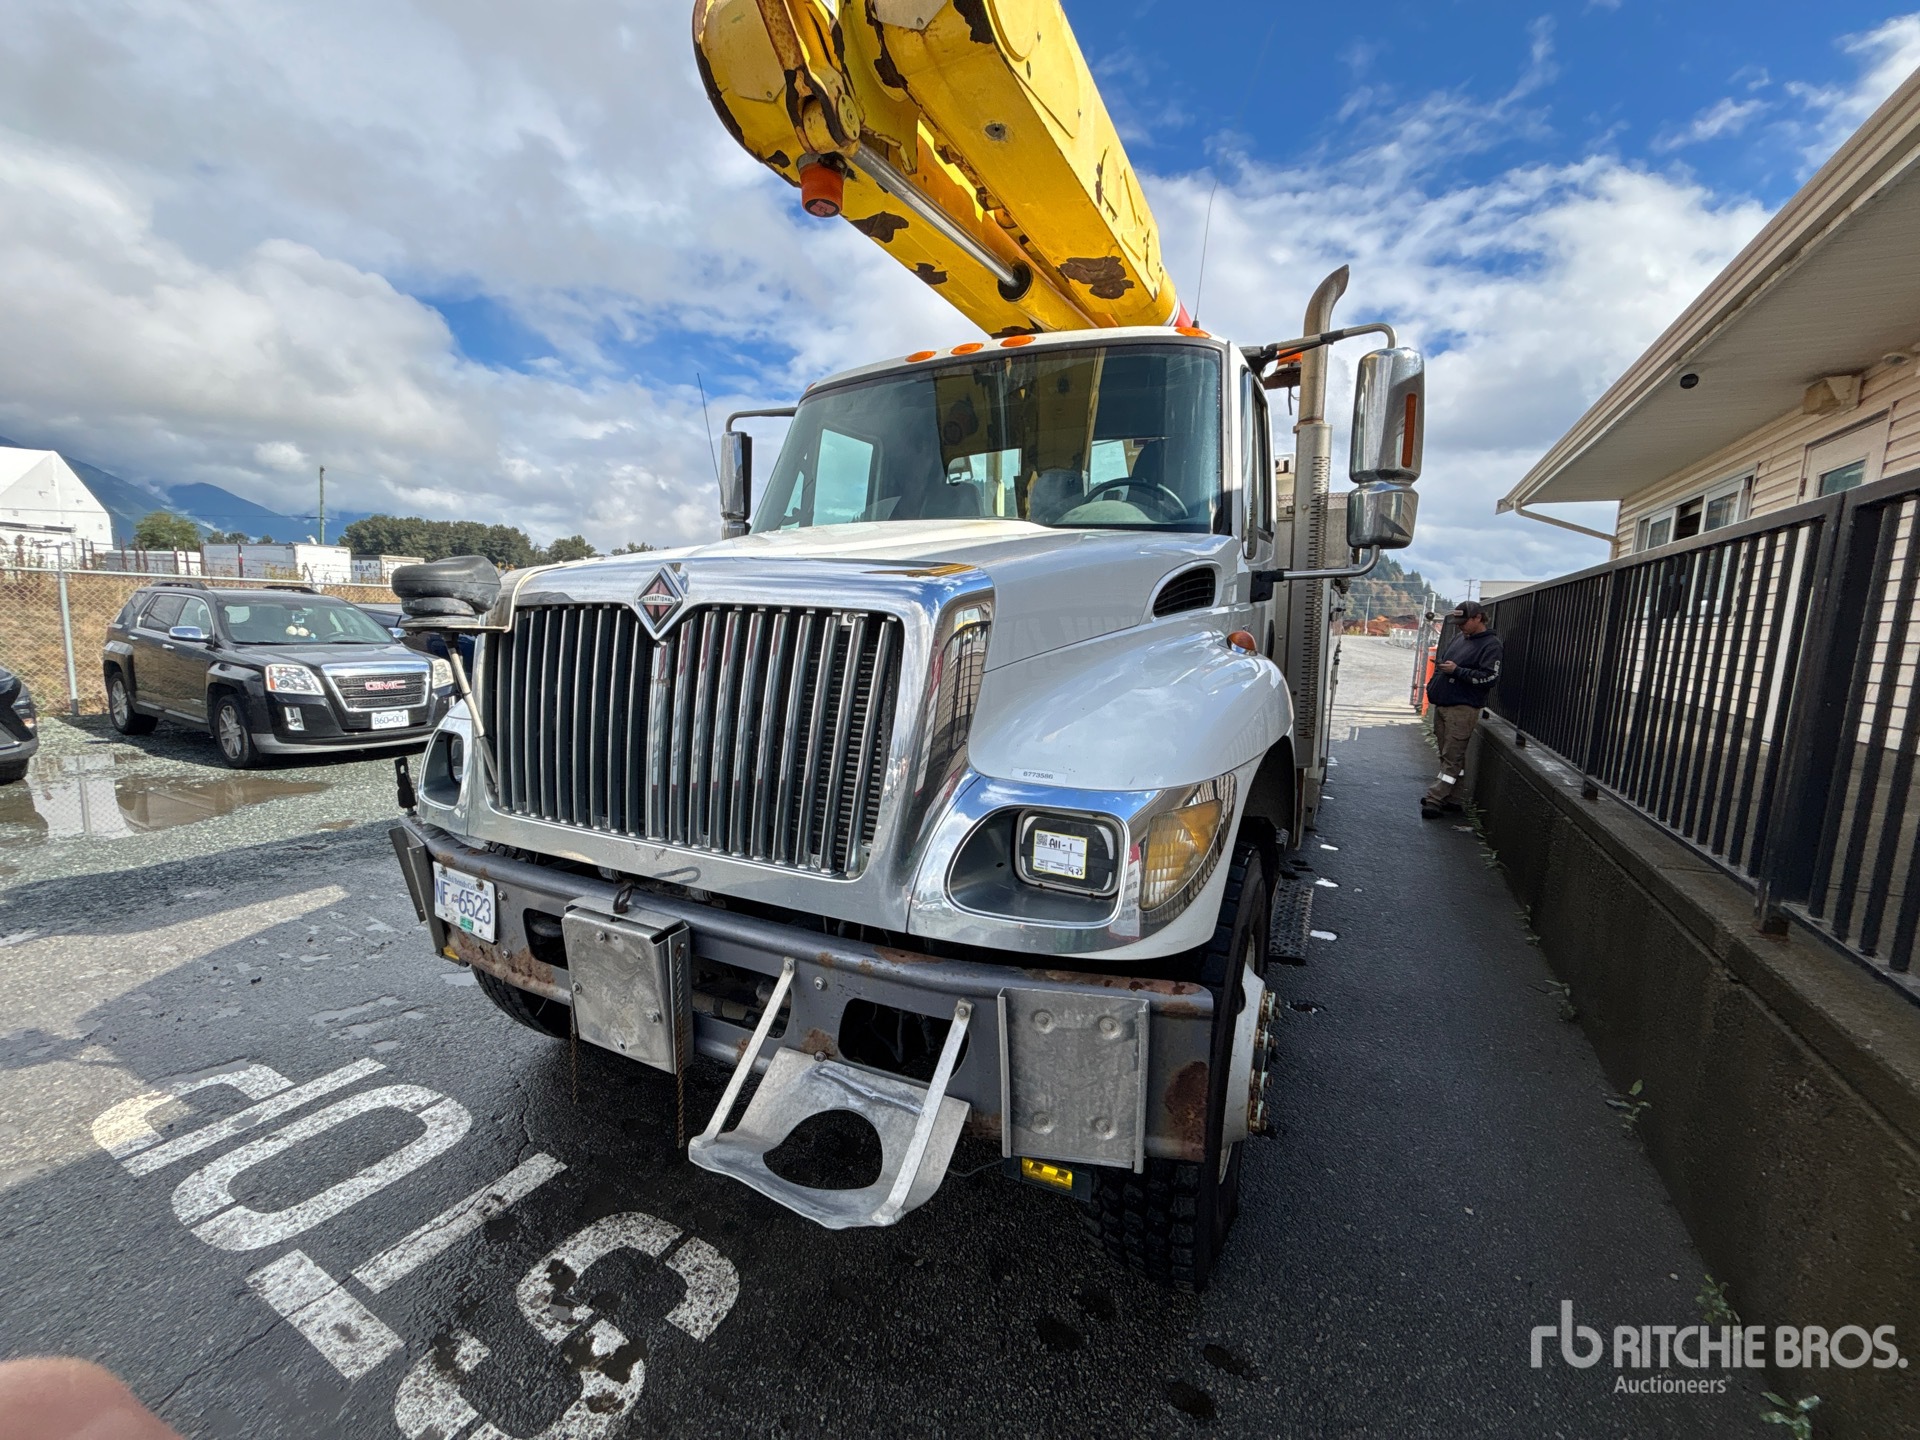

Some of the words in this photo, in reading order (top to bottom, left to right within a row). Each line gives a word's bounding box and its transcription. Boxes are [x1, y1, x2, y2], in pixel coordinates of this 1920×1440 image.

[365, 679, 407, 691] GMC
[436, 878, 450, 906] NF
[458, 889, 491, 925] 6523
[92, 1057, 740, 1440] STOP
